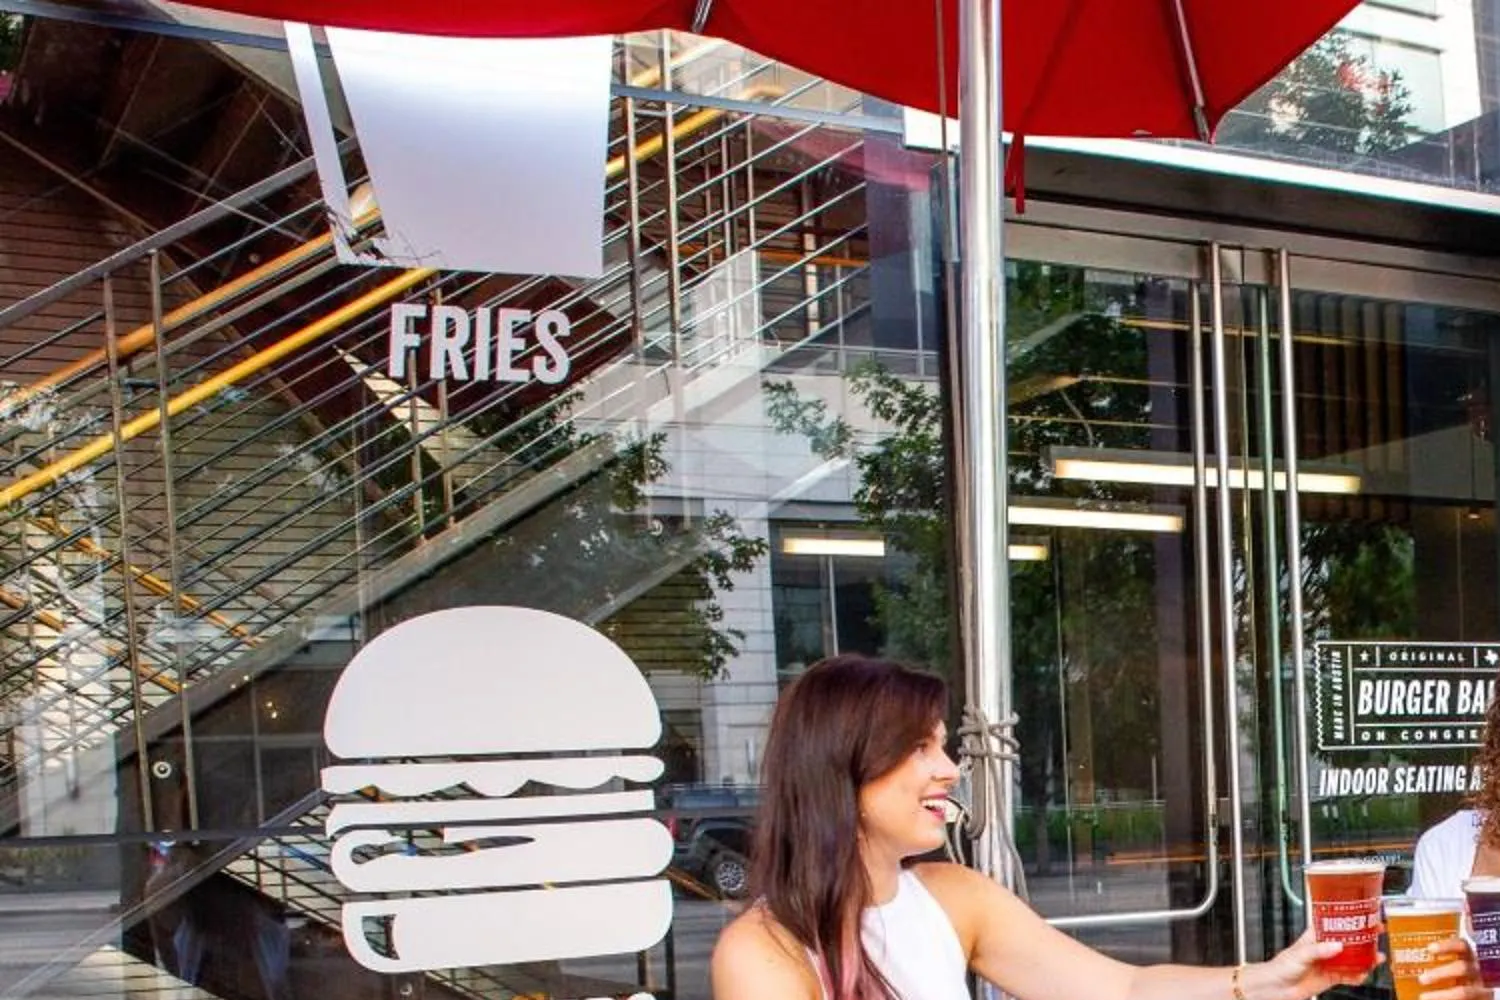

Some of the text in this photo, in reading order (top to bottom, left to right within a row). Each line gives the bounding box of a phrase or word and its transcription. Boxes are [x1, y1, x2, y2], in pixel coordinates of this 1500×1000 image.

[389, 303, 571, 385] FRIES
[1389, 652, 1465, 662] ORIGINAL
[1358, 679, 1451, 716] BURGER
[1361, 730, 1478, 741] ON CONGRE
[1319, 767, 1389, 797] INDOOR
[1393, 765, 1466, 795] SEATING
